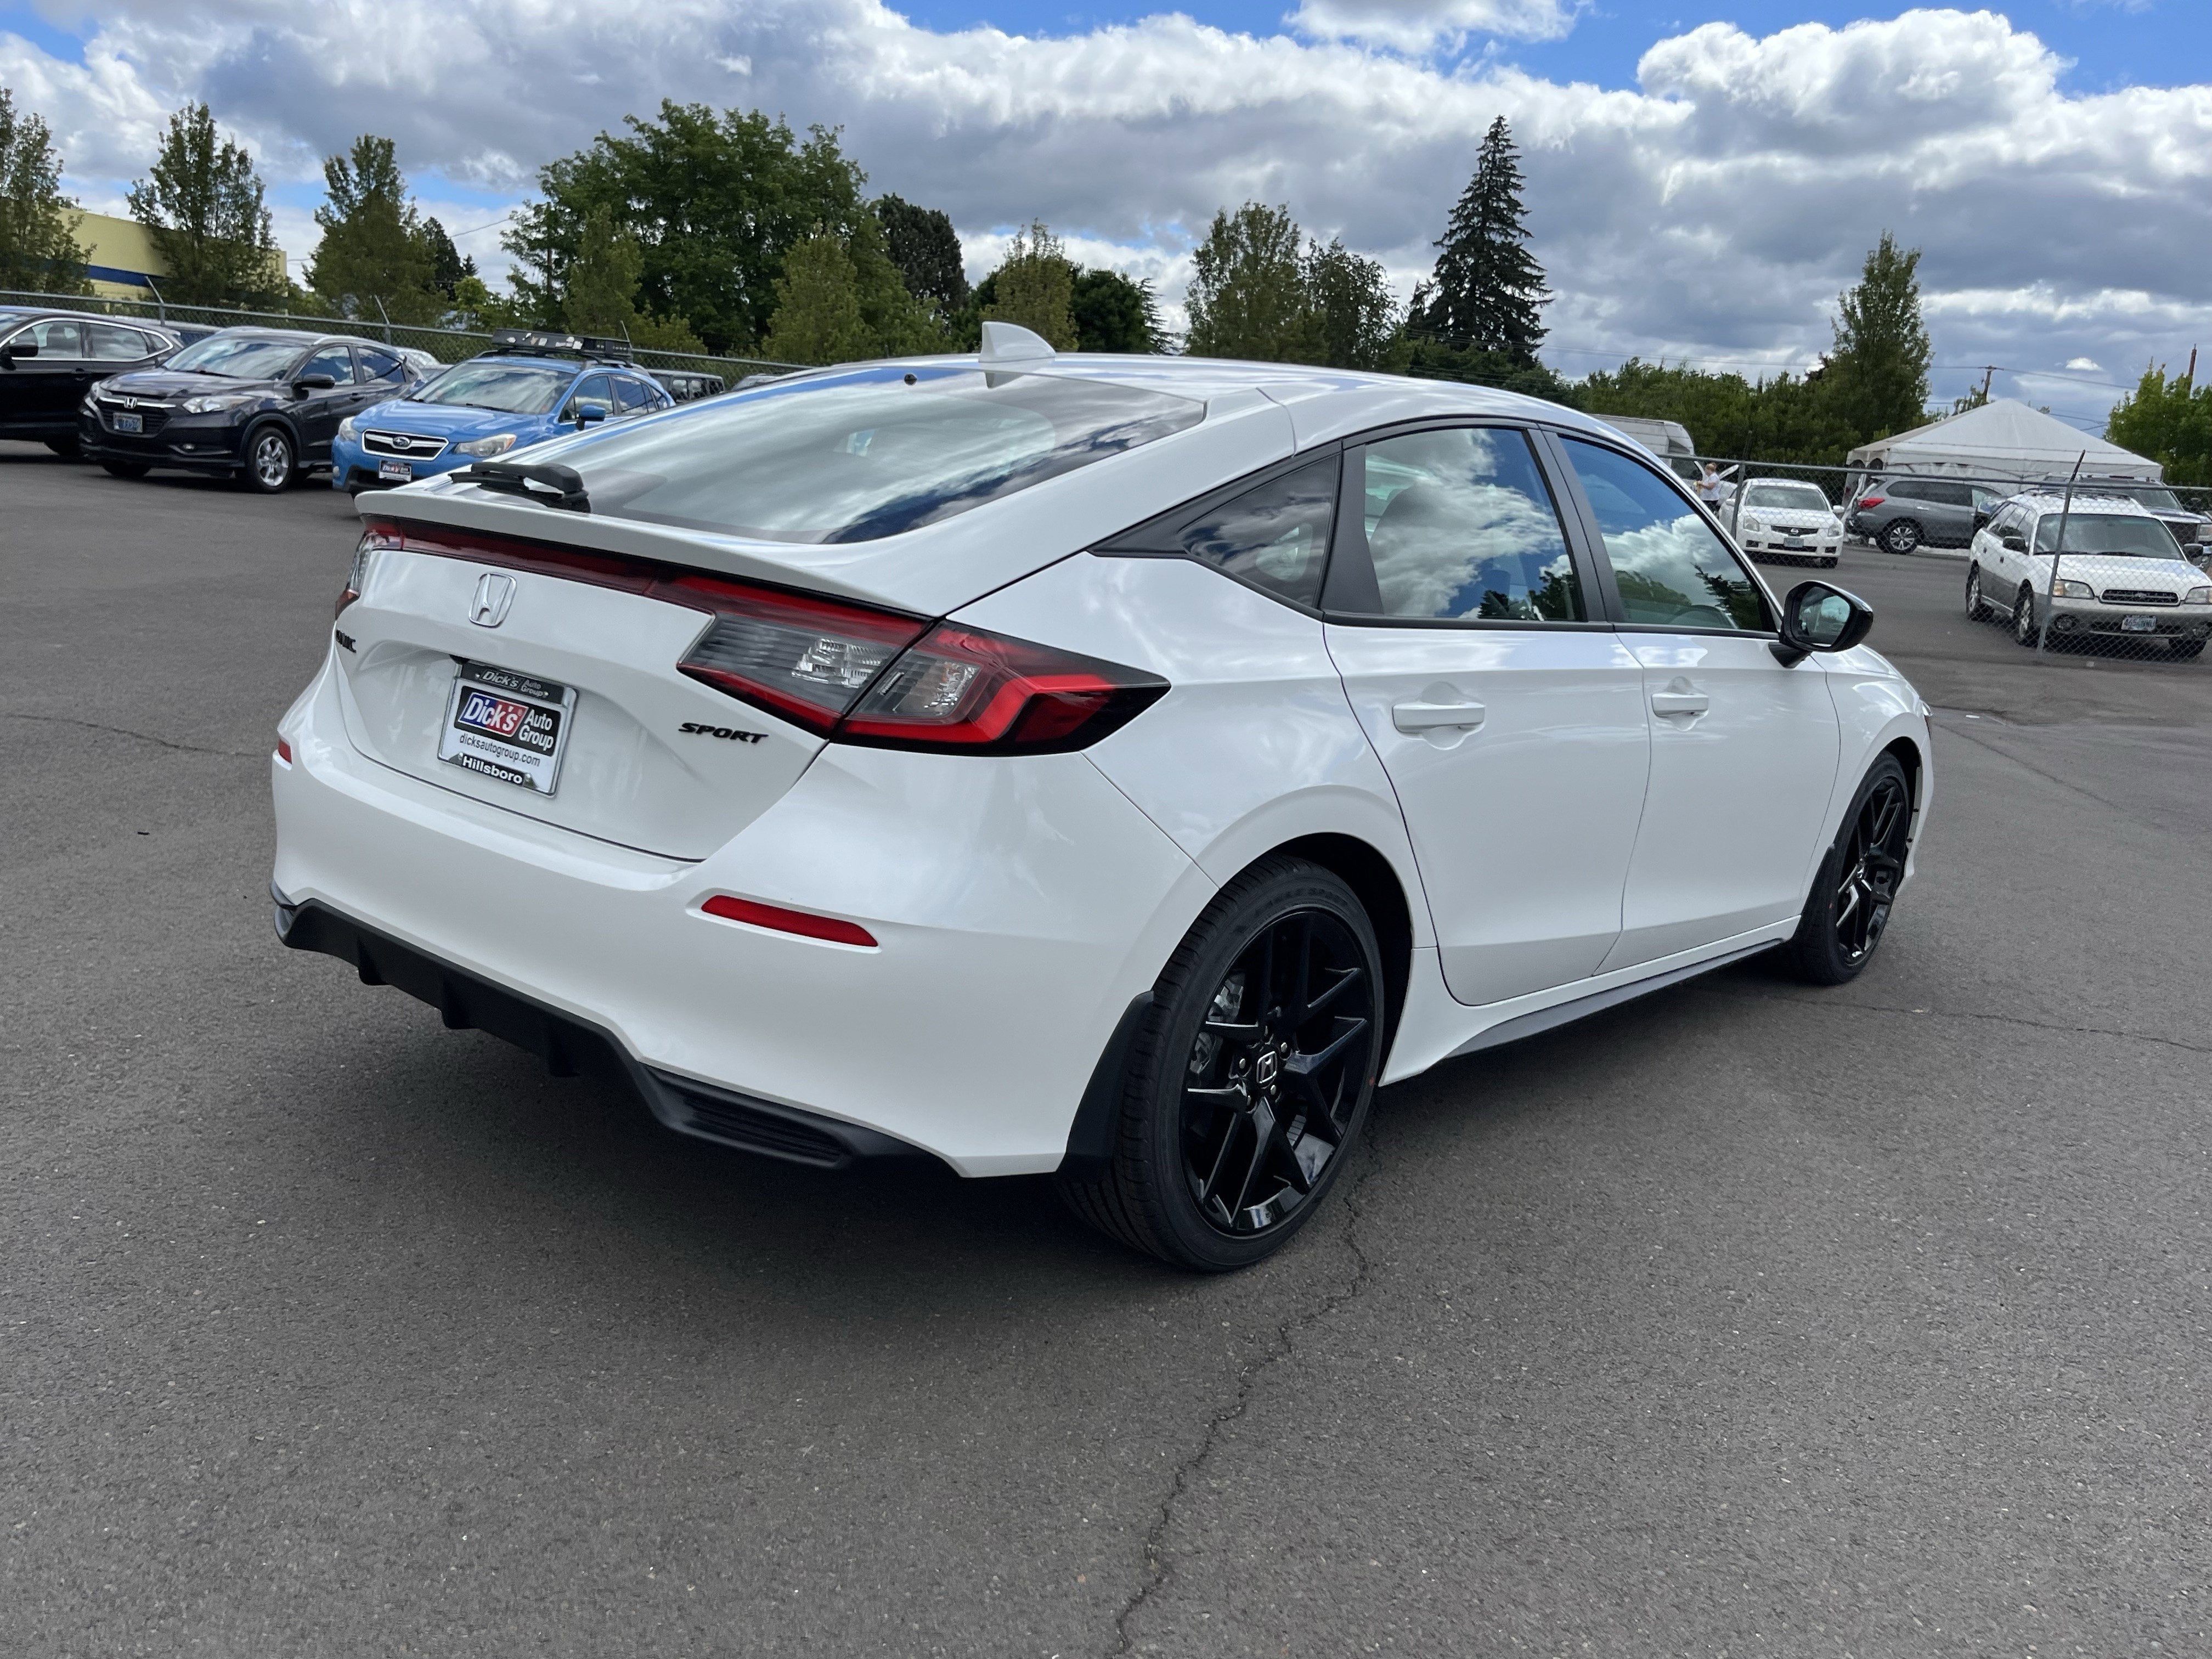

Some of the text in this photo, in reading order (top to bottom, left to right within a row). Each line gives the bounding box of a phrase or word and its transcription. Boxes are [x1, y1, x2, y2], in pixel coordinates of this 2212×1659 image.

[482, 670, 519, 688] Dick's
[464, 697, 518, 731] Dick's
[523, 709, 552, 731] Auto
[518, 725, 554, 751] Group
[678, 722, 769, 743] SPORT
[459, 733, 541, 767] dicksautogroup.com
[462, 755, 523, 785] Hillsboro
